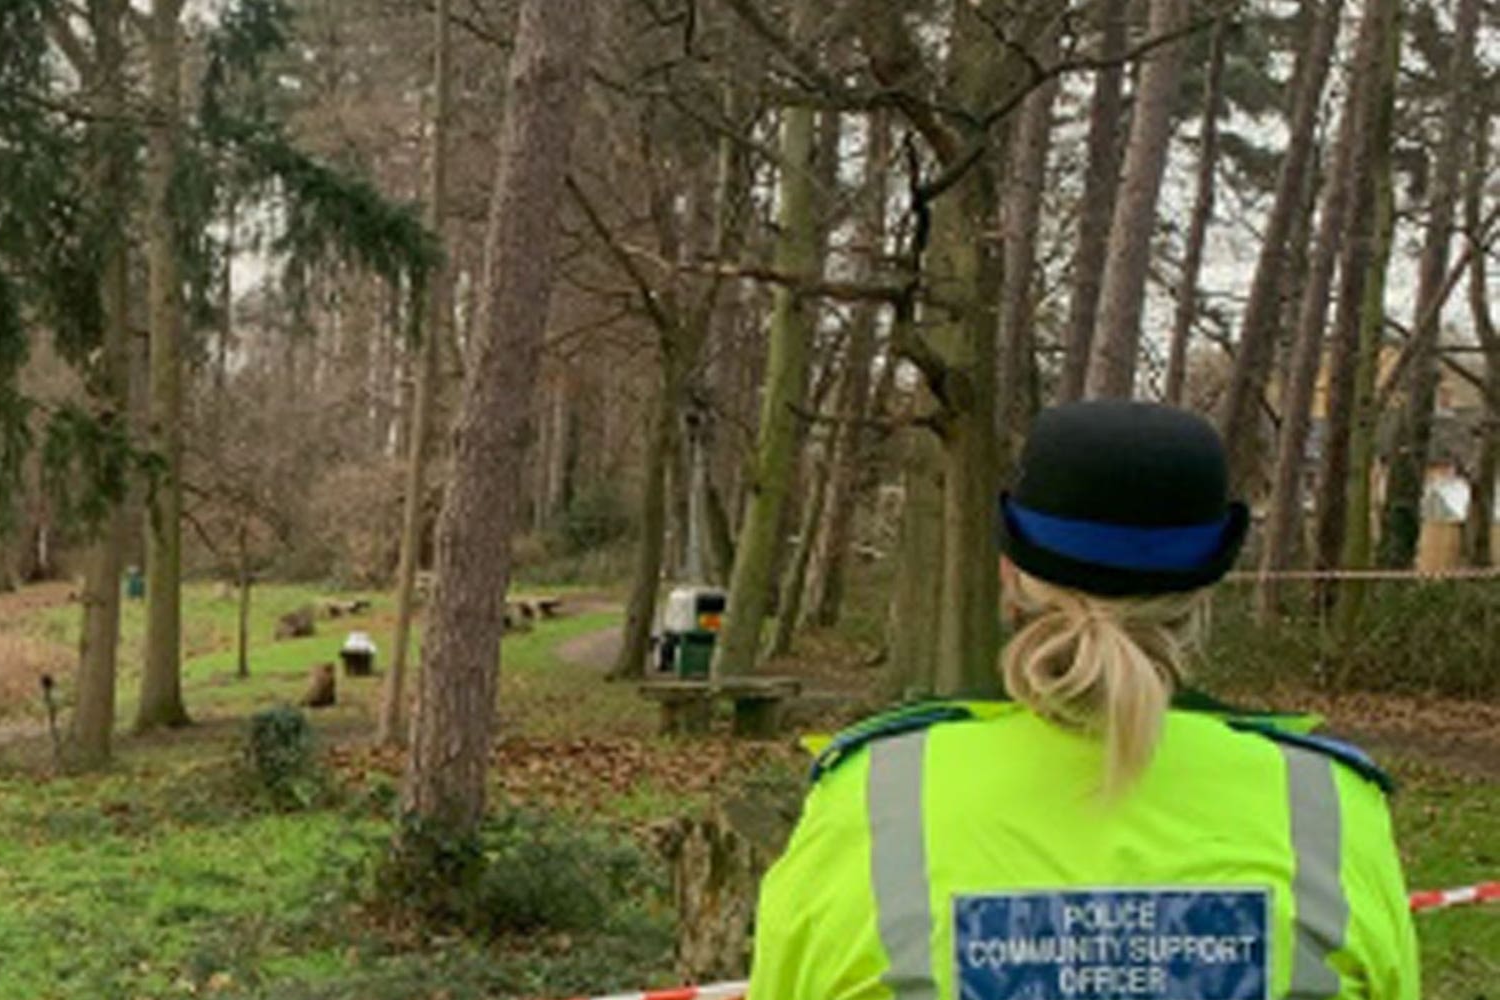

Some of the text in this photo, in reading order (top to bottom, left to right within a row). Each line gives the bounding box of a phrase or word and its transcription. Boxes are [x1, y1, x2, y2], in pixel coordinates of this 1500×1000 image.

[1064, 902, 1157, 931] POLICE
[970, 936, 1256, 967] COMMUNITY SUPPORT
[1058, 967, 1167, 994] OFFICER
